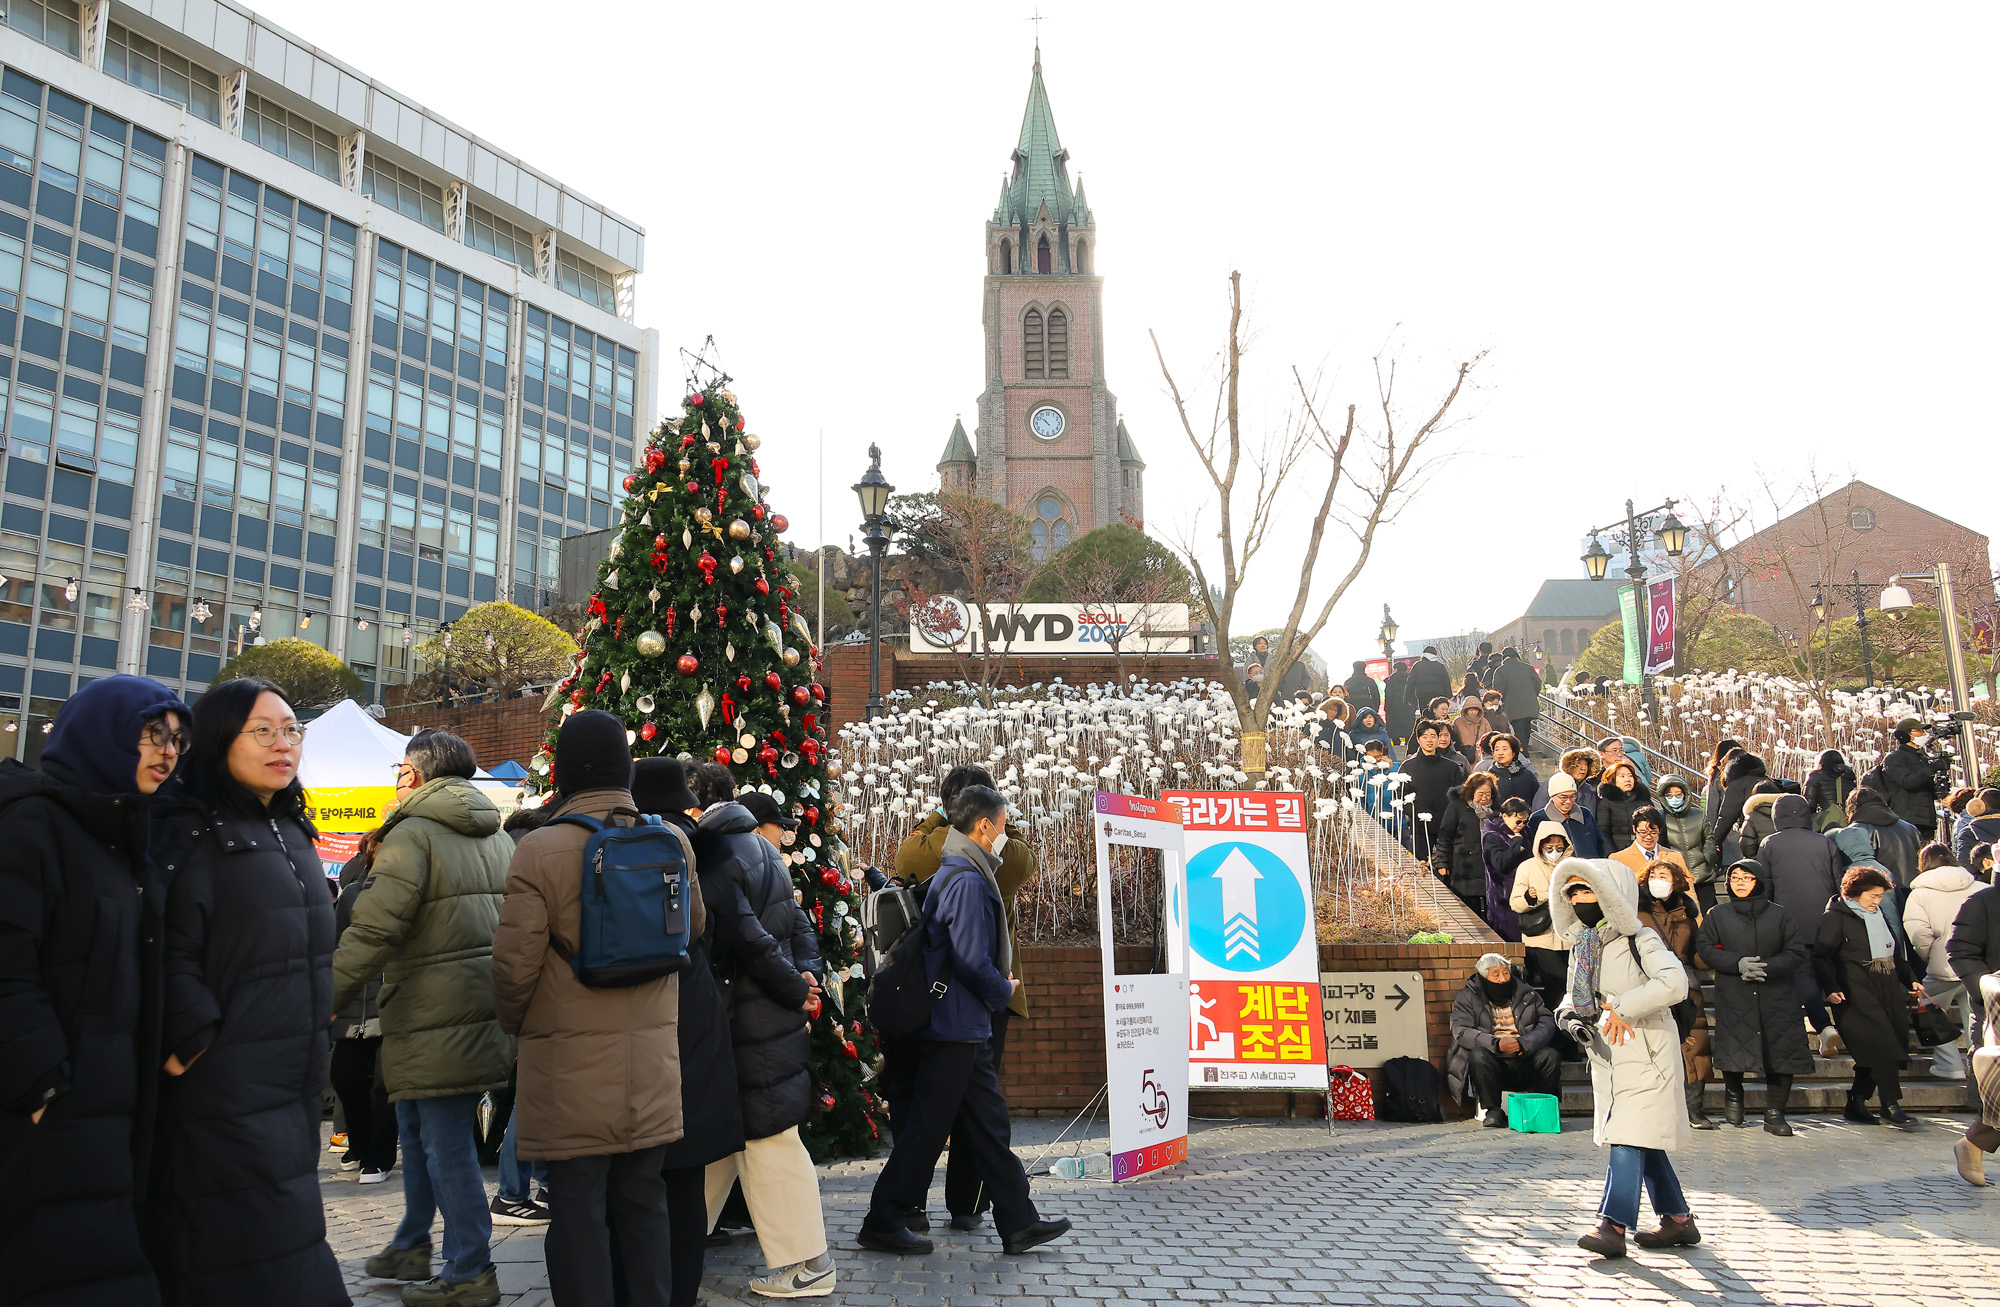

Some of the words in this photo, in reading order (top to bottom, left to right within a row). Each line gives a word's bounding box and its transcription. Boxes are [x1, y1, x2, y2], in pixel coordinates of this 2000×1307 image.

[985, 614, 1074, 641] WYD
[1078, 613, 1127, 624] SEOUL
[1078, 625, 1127, 642] 2027
[320, 807, 376, 821] 달아주세요
[1128, 799, 1157, 817] Instagram
[1275, 799, 1302, 828] 길
[1113, 827, 1147, 838] Caritas_Seoul
[328, 863, 344, 876] 사
[1321, 983, 1375, 1000] 교구청
[1238, 985, 1310, 1021] 계단
[1344, 1008, 1376, 1024] 채플
[1241, 1024, 1312, 1061] 조심
[1326, 1033, 1378, 1050] 스코홀
[1250, 1070, 1296, 1080] 서울대교구
